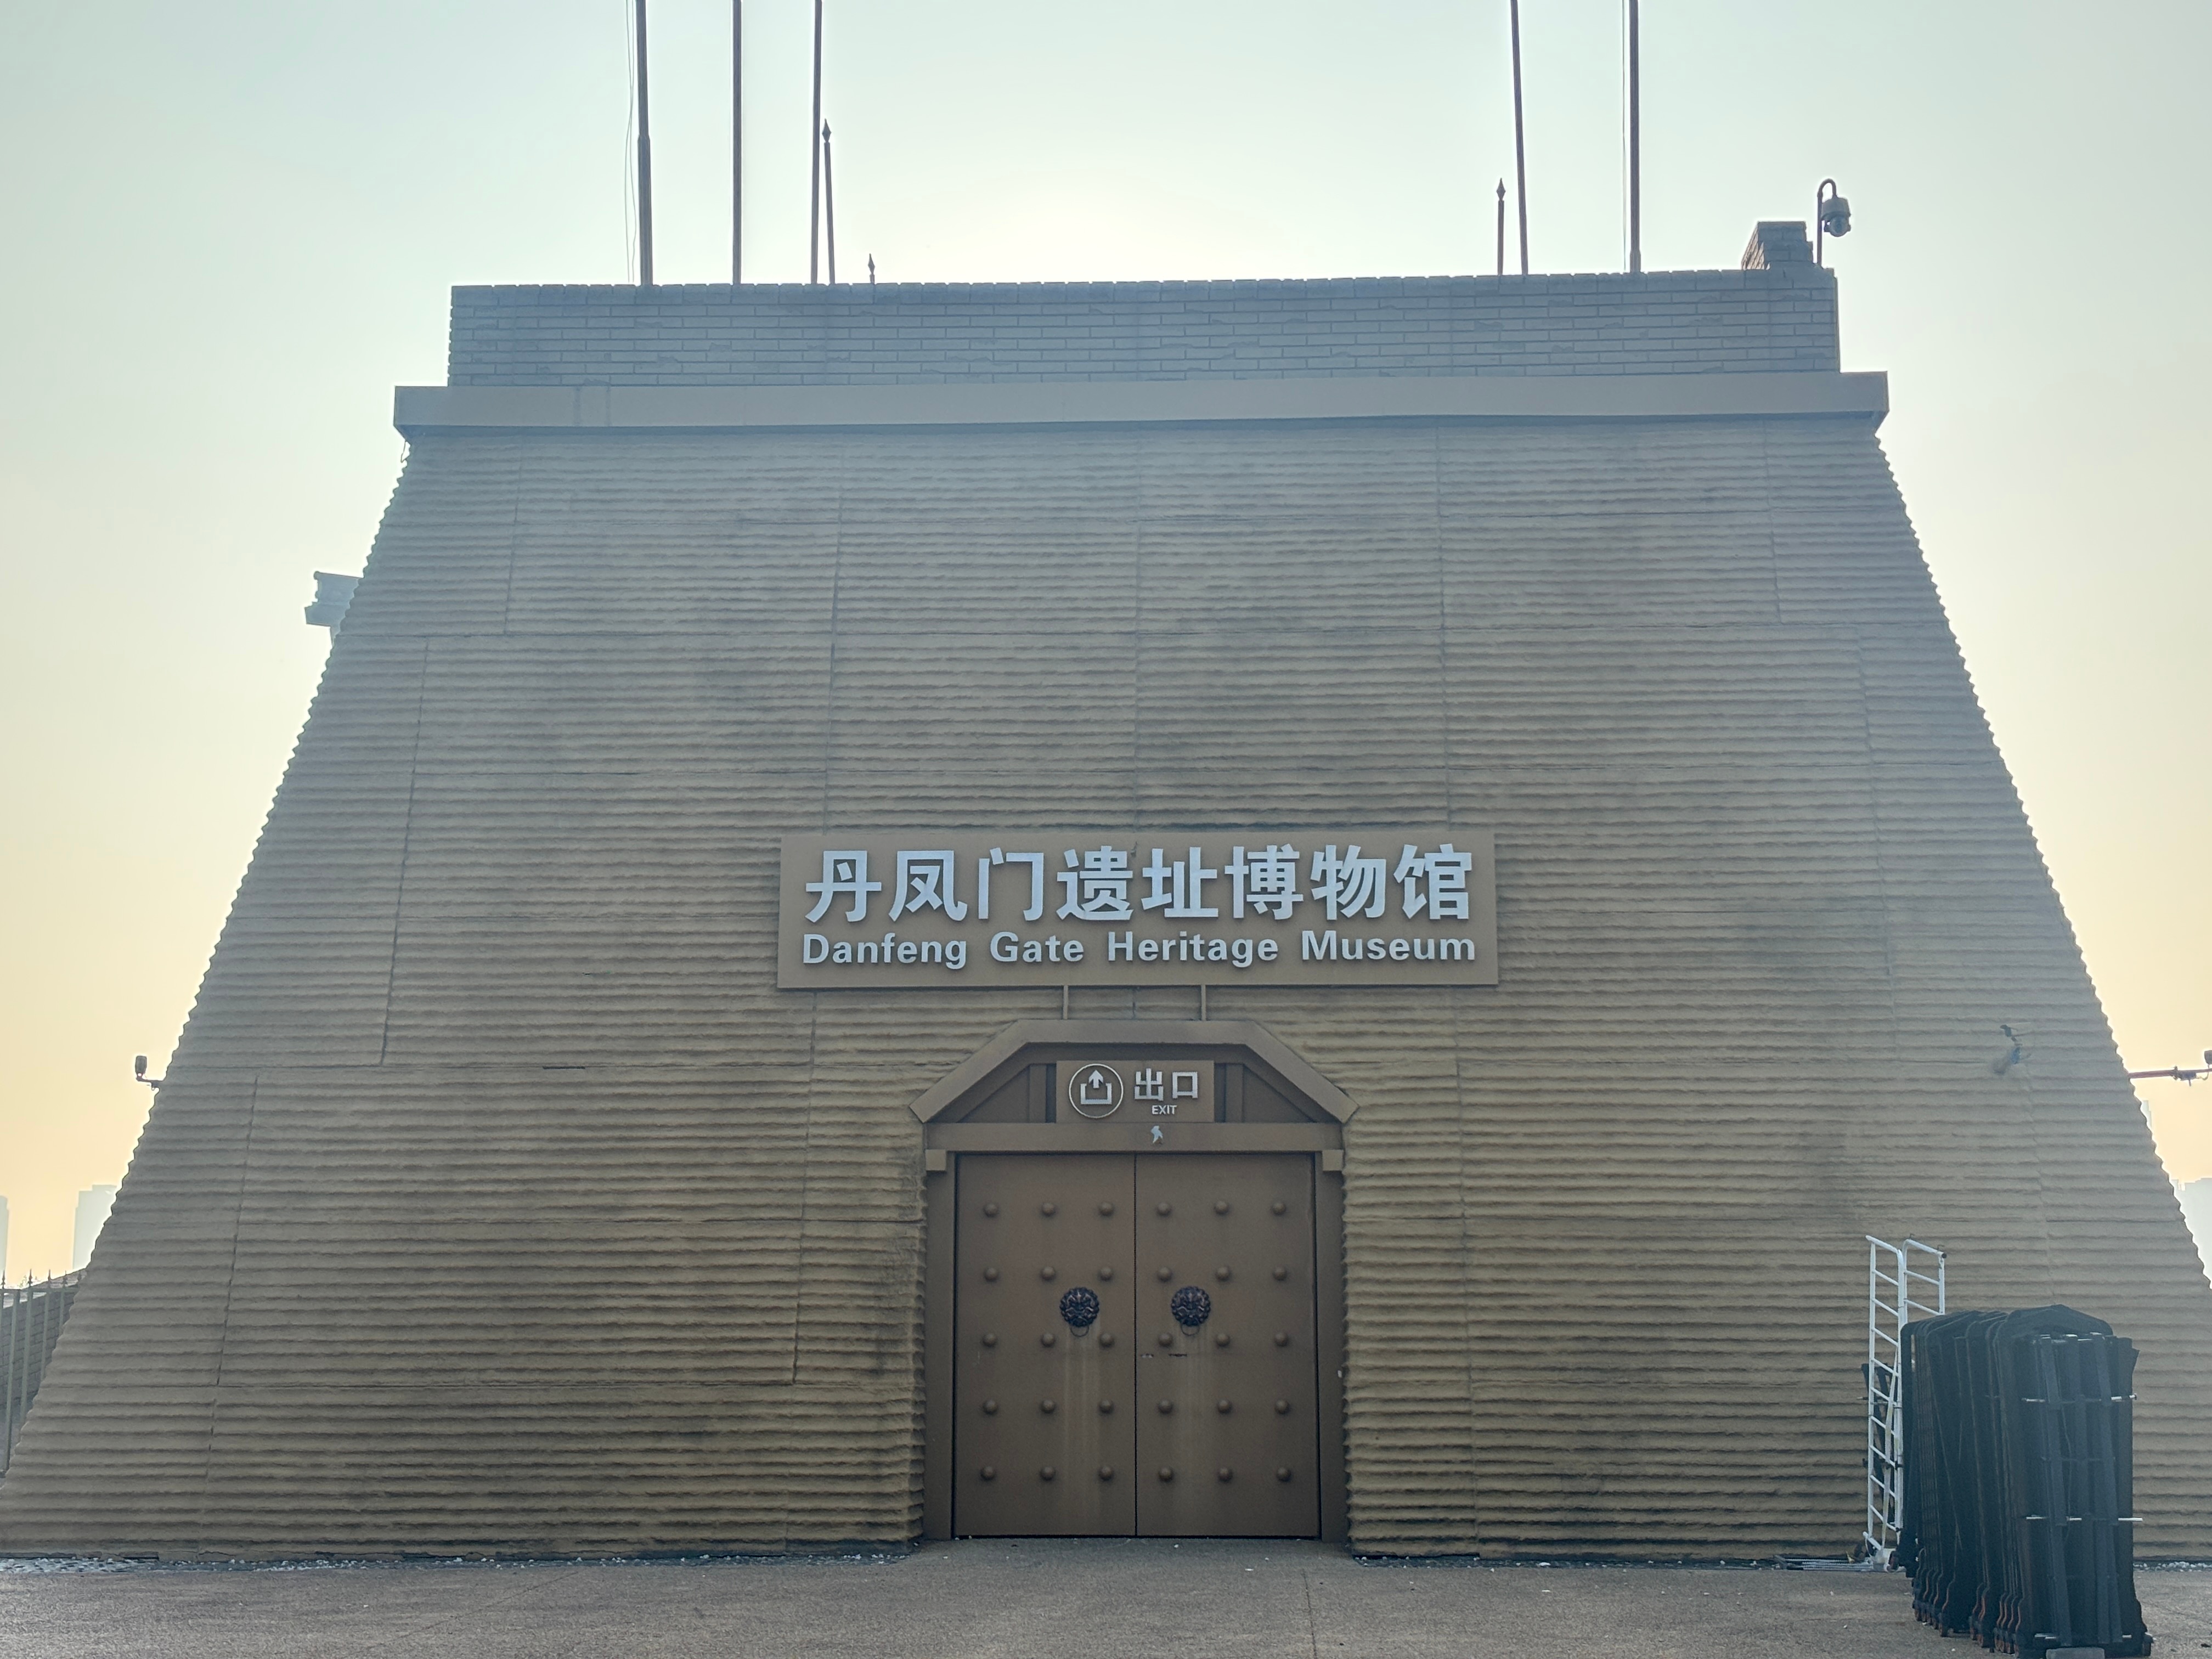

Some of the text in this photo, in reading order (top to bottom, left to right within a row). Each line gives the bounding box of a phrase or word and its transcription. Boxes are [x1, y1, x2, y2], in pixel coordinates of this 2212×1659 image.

[805, 843, 1472, 923] 丹凤门遗址博物馆
[803, 930, 1475, 969] Danfeng Gate Heritage Museum
[1134, 1068, 1198, 1101] 出口
[1152, 1104, 1177, 1115] EXIT
